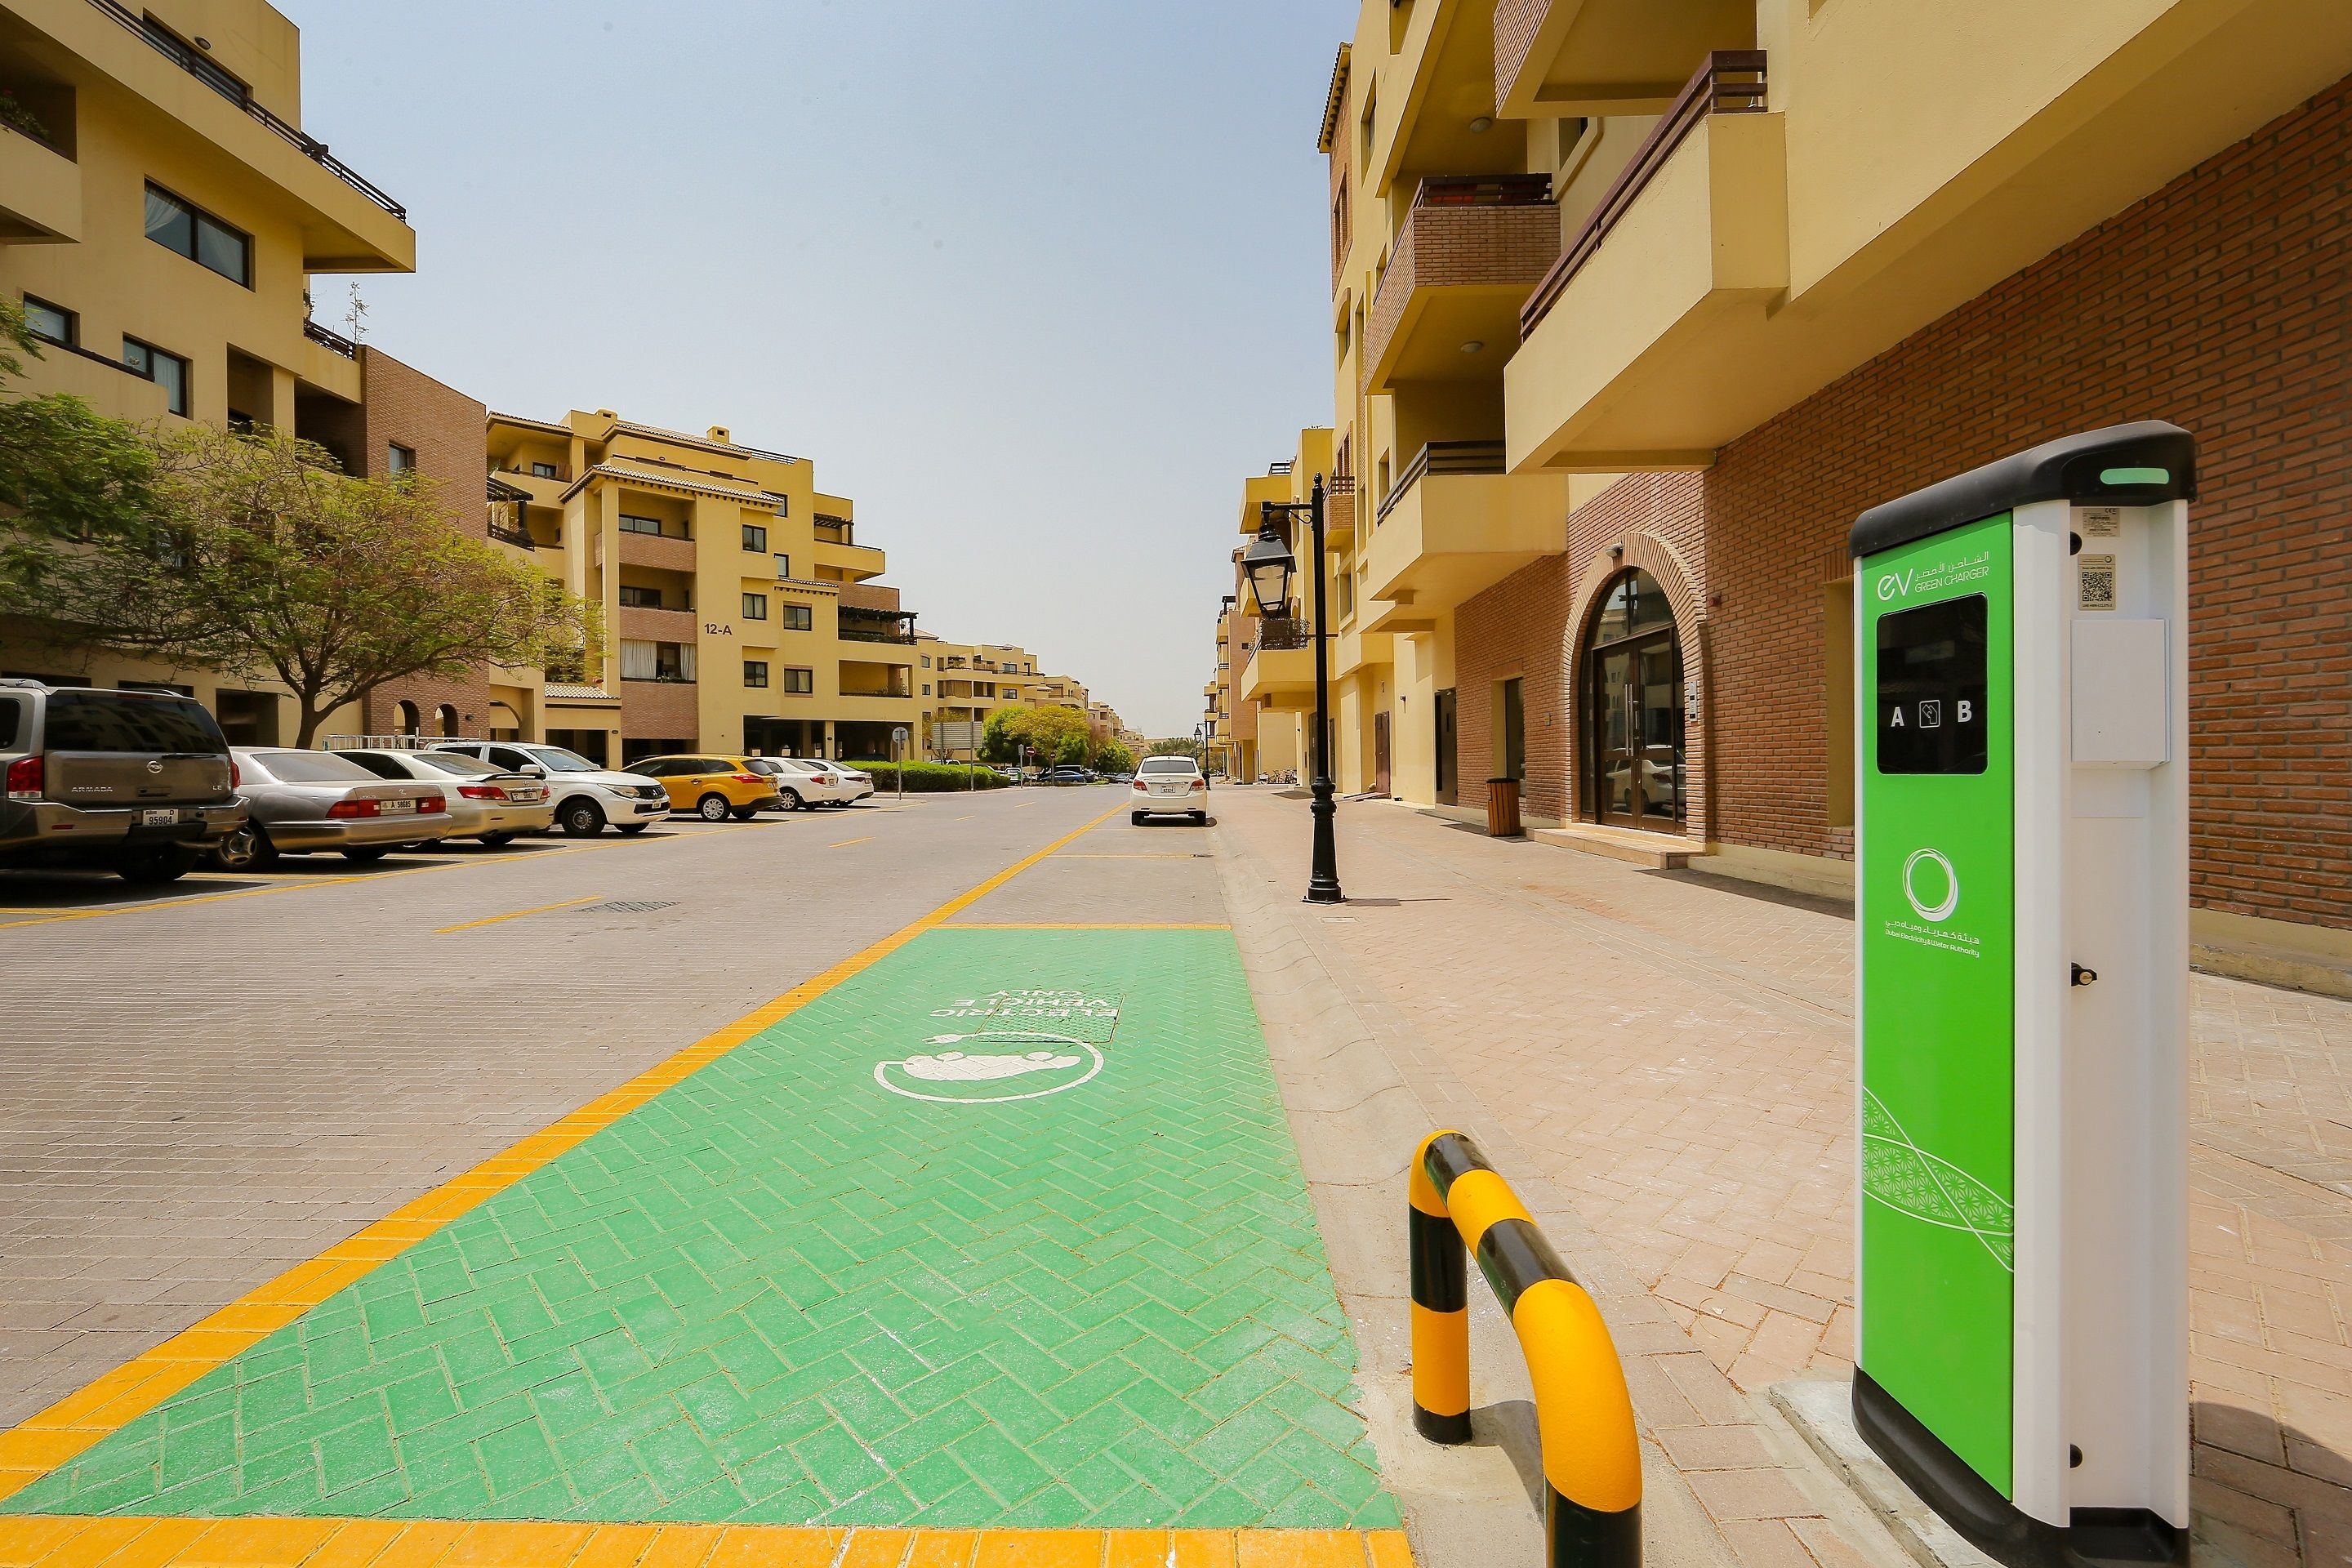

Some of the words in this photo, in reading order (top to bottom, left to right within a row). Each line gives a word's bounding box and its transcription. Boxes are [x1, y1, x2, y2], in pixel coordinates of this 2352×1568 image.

[1914, 577, 1944, 593] GREEN
[1944, 566, 1989, 586] CHARGER
[704, 623, 733, 635] 12-A
[1891, 706, 1905, 728] A
[1958, 700, 1973, 723] B
[149, 816, 173, 826] 95904
[1885, 929, 1900, 938] Dubai
[1949, 944, 1980, 958] Authority
[951, 998, 1110, 1007] VEHICLE
[929, 1008, 1119, 1018] ELECTRIC
